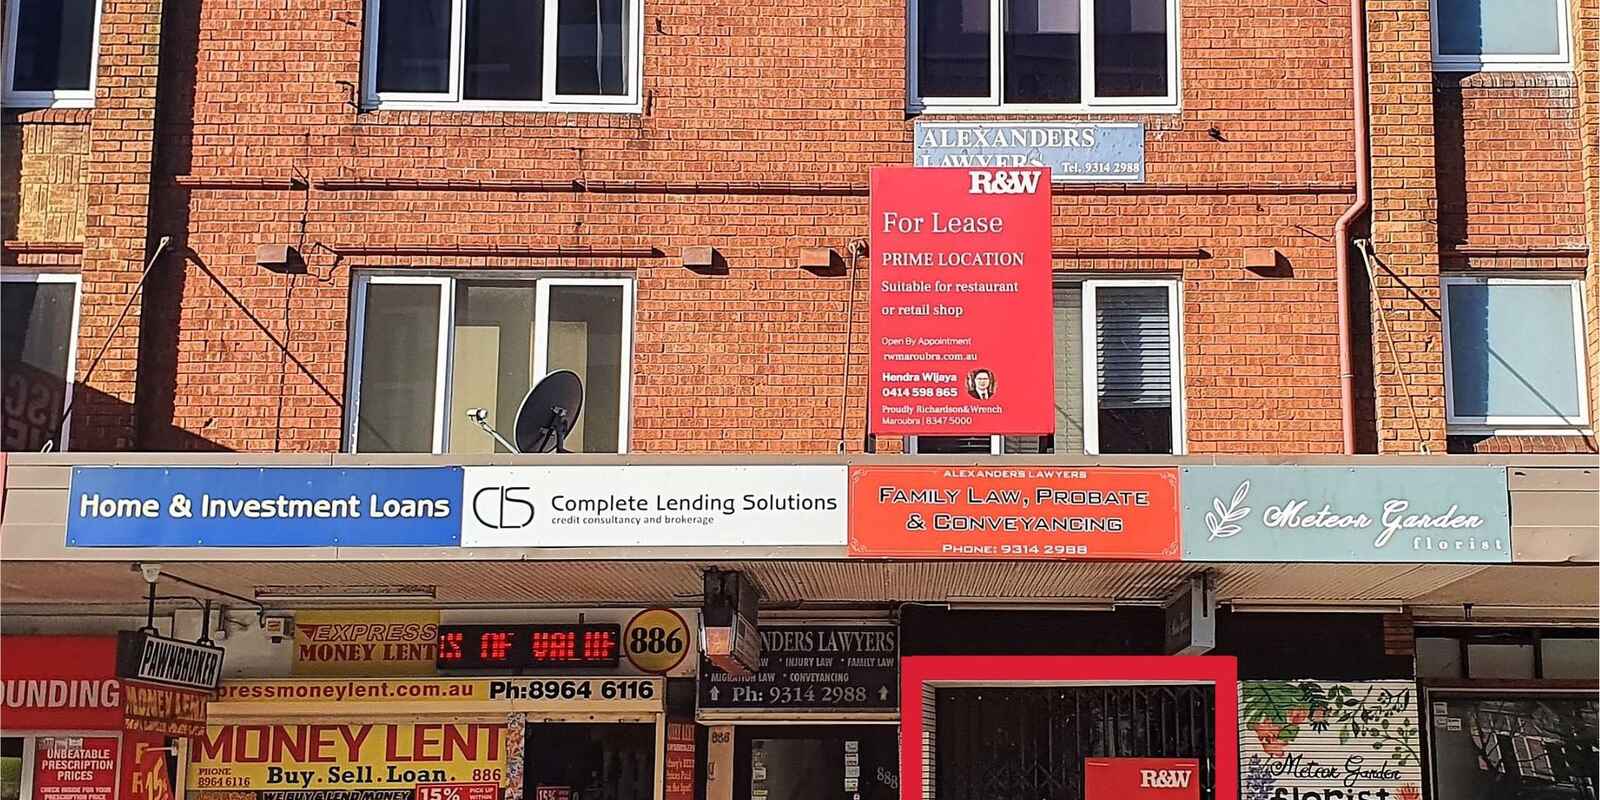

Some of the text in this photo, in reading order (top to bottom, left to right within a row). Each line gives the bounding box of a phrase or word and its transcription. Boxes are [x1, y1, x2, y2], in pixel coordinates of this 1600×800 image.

[920, 128, 1095, 148] ALEXANDERS
[1085, 162, 1110, 173] 9314
[1113, 162, 1140, 173] 2988
[969, 171, 1041, 194] R&W
[883, 212, 1003, 233] For Lease
[882, 252, 1024, 266] PRIME LOCATION
[881, 280, 1018, 292] Suitable for restaurant
[881, 303, 963, 317] or retail shop
[881, 337, 971, 347] Open By Appointment
[883, 352, 977, 361] rwmaroubra.com.au
[882, 372, 957, 384] Hendra Wijaya
[882, 387, 958, 397] 0414 598 865
[881, 405, 913, 415] Proudly
[881, 417, 972, 425] Maroubra 8347 5000
[943, 470, 1087, 479] ALEXANDERS LAWYERS
[879, 487, 959, 505] FAMILY
[1036, 487, 1150, 505] PROBATE
[79, 494, 450, 518] Home & Investment Loans
[551, 494, 838, 516] Complete Lending Solutions
[551, 516, 715, 526] credit consultancy and brokerage
[905, 514, 1123, 533] & CONVEYANCING
[1263, 500, 1484, 548] Meteor Garden
[942, 543, 1088, 555] PHONE: 9314 2988
[1412, 537, 1504, 551] florist
[312, 624, 438, 642] EXPRESS
[630, 626, 683, 654] 886
[818, 631, 895, 652] LAWYERS
[299, 643, 439, 661] MONEY LENT
[140, 639, 219, 687] PAWNBROKER
[785, 657, 833, 667] INJURY LAW
[847, 657, 895, 667] FAMILY LAW
[758, 673, 775, 683] LAW
[790, 673, 849, 683] CONVEYANCING
[0, 679, 120, 708] UNDING
[490, 680, 592, 700] Ph:8964
[601, 681, 655, 700] 6116
[732, 686, 867, 704] Ph: 9314 2988
[192, 724, 374, 763] MONEY
[385, 724, 507, 763] LENT
[47, 749, 110, 759] UNBEATABLE
[41, 760, 113, 770] PRESCRIPTION
[198, 767, 232, 776] PHONE
[1270, 753, 1402, 788] Meteor Garden
[57, 771, 93, 781] PRICES
[225, 777, 251, 786] 6116
[472, 768, 502, 781] 886
[1140, 770, 1192, 788] R&W
